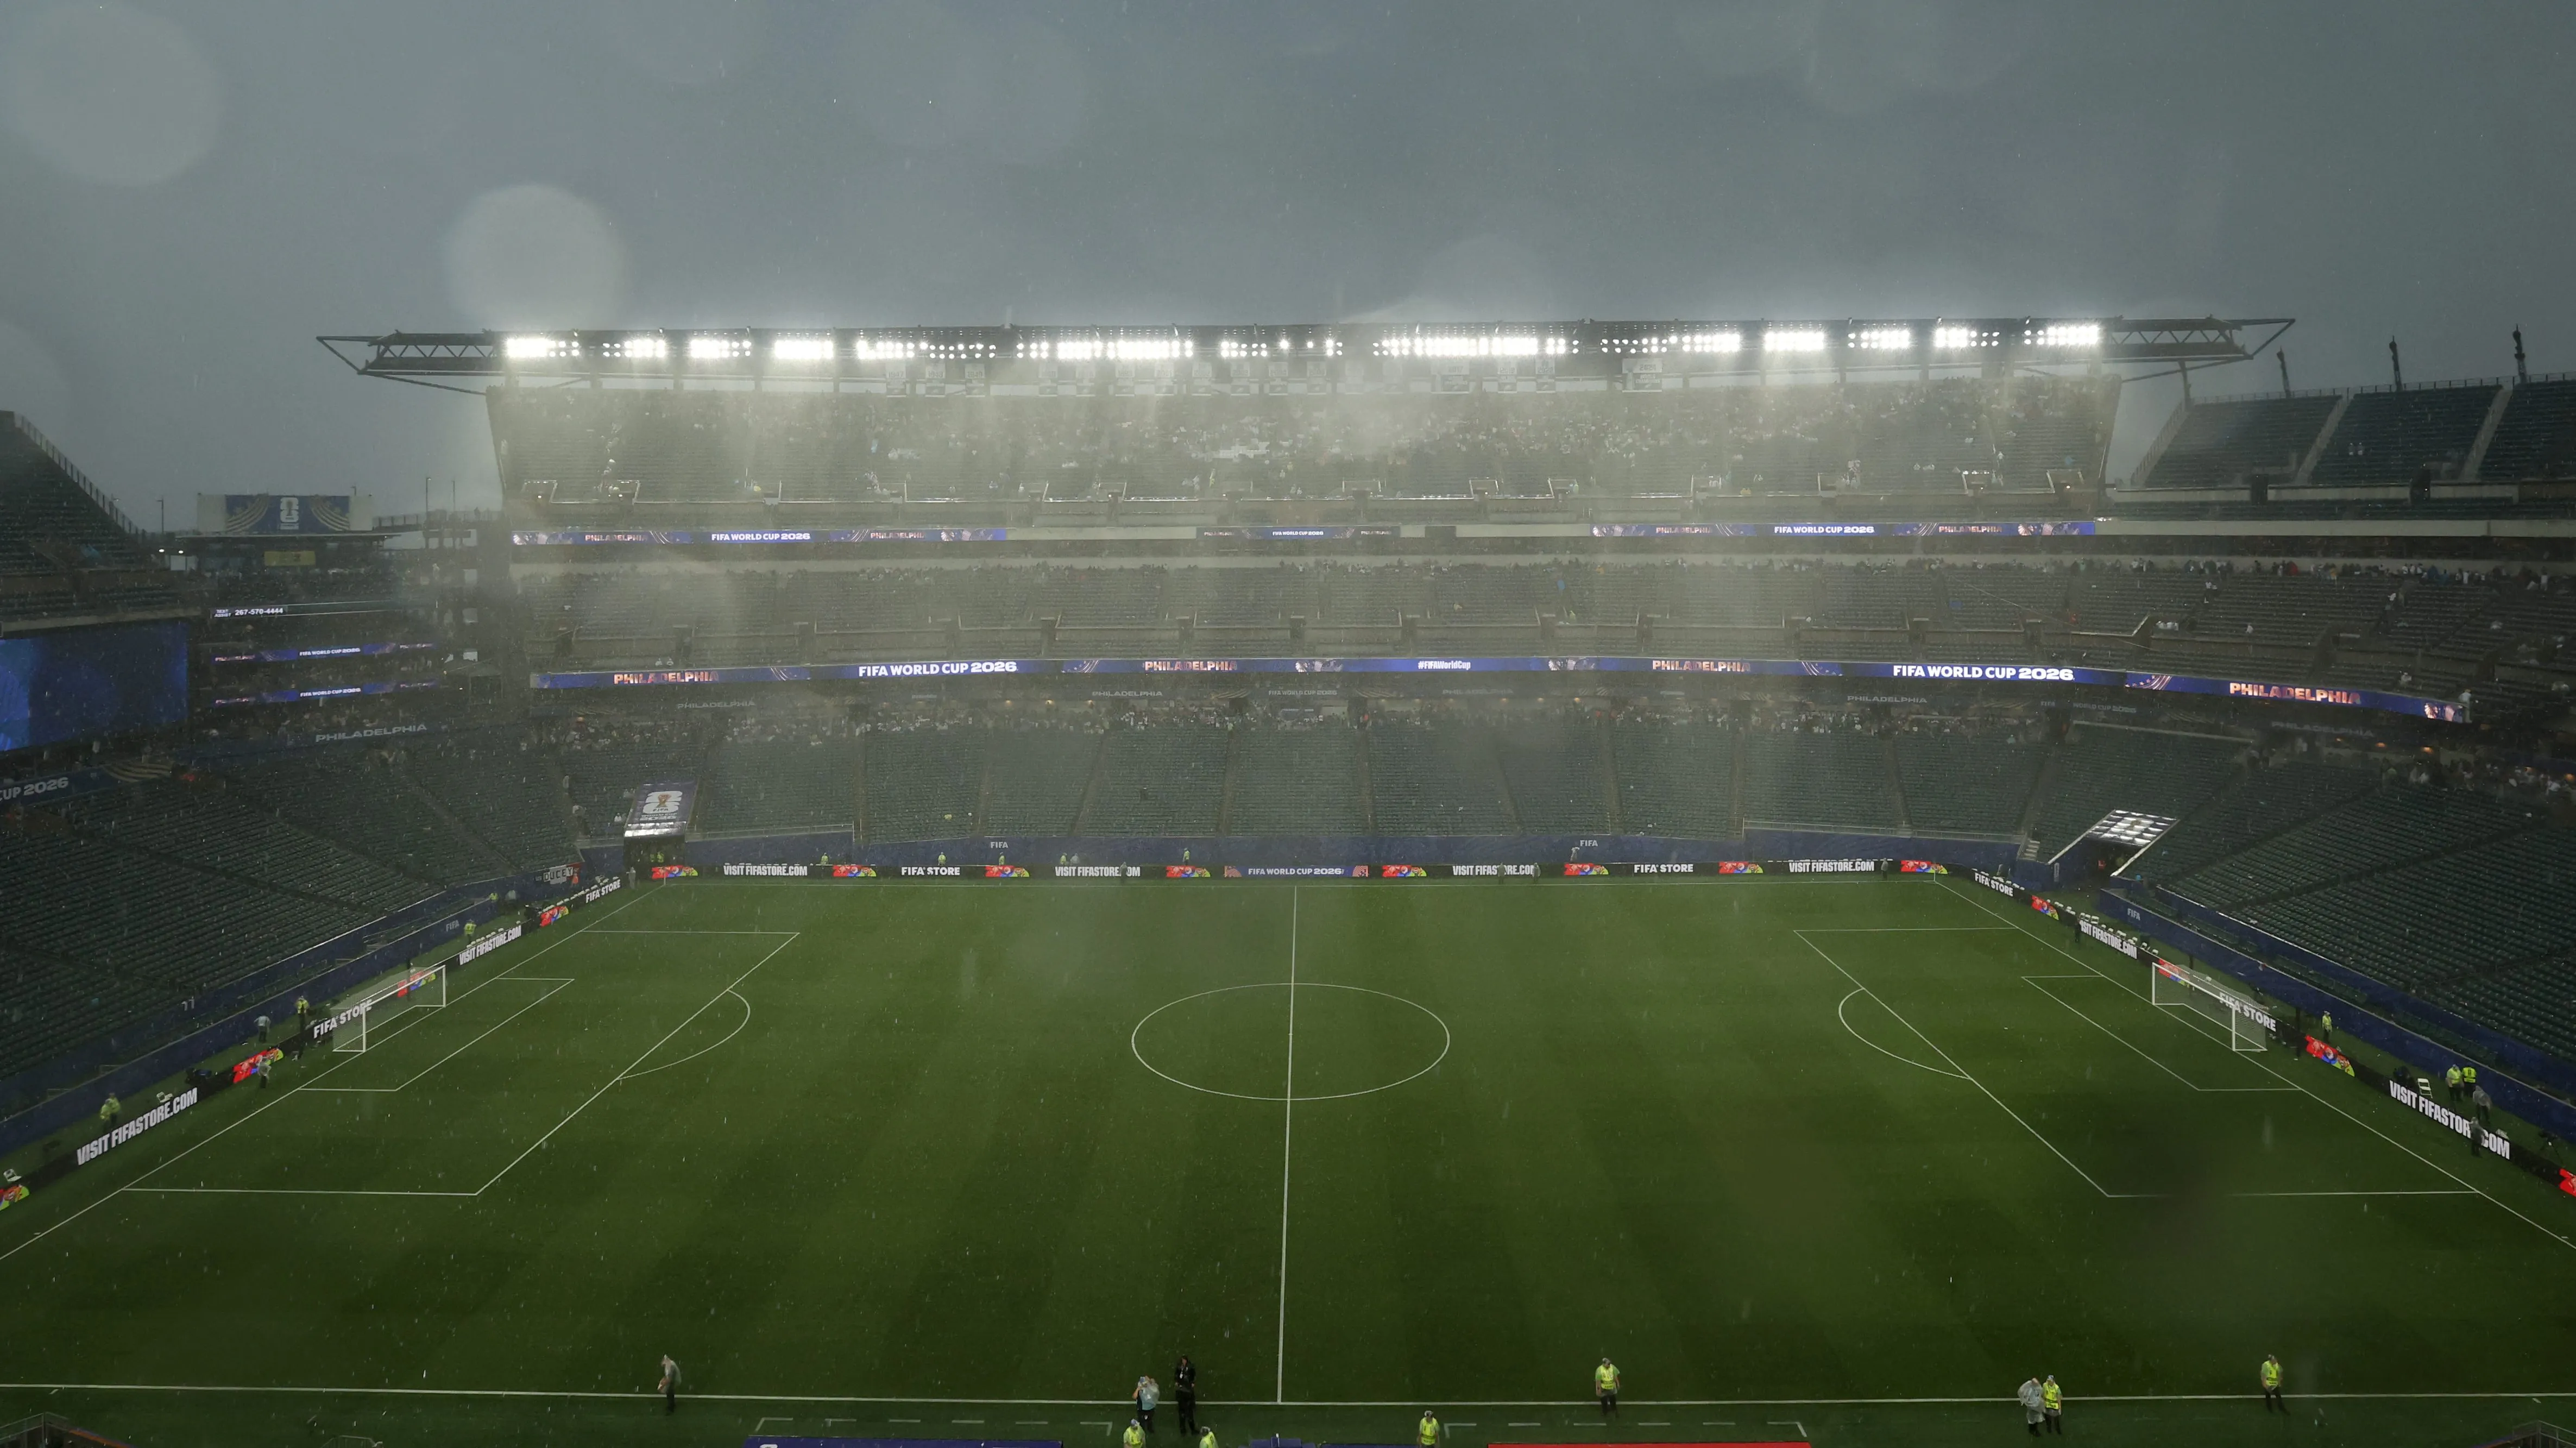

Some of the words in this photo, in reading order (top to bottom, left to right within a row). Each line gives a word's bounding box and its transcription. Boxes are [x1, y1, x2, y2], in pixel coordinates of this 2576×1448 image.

[235, 607, 284, 616] 267-570-4444
[859, 665, 889, 677] FIFA
[891, 664, 940, 676] WORLD
[942, 663, 968, 673] CUP
[971, 662, 1017, 672] 2026
[1145, 661, 1237, 671] PHILADELPHIA
[1418, 660, 1471, 670] #FIFAWorldCup
[1653, 660, 1751, 672] PHILADELPHIA
[614, 671, 719, 684] PHILADELPHIA
[1893, 665, 1925, 677] FIFA
[1926, 666, 1982, 678] WORLD
[1985, 667, 2016, 679] CUP
[2018, 668, 2074, 681] 2026
[1847, 695, 1928, 703] PHILADELPHIA
[2229, 682, 2361, 704] PHILADELPHIA
[677, 701, 756, 709] PHILADELPHIA
[316, 724, 427, 742] PHILADELPHIA
[2271, 721, 2375, 738] PHILADELPHIA
[23, 777, 69, 796] 2026
[723, 865, 745, 876] VISIT
[746, 865, 808, 876] FIFASTORE.COM
[927, 866, 960, 876] STORE
[1055, 866, 1077, 877] VISIT
[1078, 866, 1141, 877] FIFASTORE.OM
[1452, 866, 1474, 876] VISIT
[1660, 864, 1693, 872] STORE
[1789, 862, 1811, 872] VISIT
[1811, 861, 1874, 872] FIFASTORE.COM
[544, 868, 572, 881] DUCEY
[601, 879, 621, 896] STORE
[1991, 879, 2013, 897] STORE
[2127, 908, 2140, 921] FIFA
[446, 920, 459, 933] FIFA
[459, 947, 476, 966] VISIT
[476, 925, 522, 957] FIFASTORE.COM
[2092, 924, 2137, 960] FIFASTORE.COM
[2243, 1005, 2276, 1032] STORE
[77, 1133, 110, 1166] VISIT
[111, 1087, 198, 1148] FIFASTORE.COM
[2389, 1080, 2417, 1109] VISIT
[2418, 1096, 2510, 1160] FIFASTORCOM
